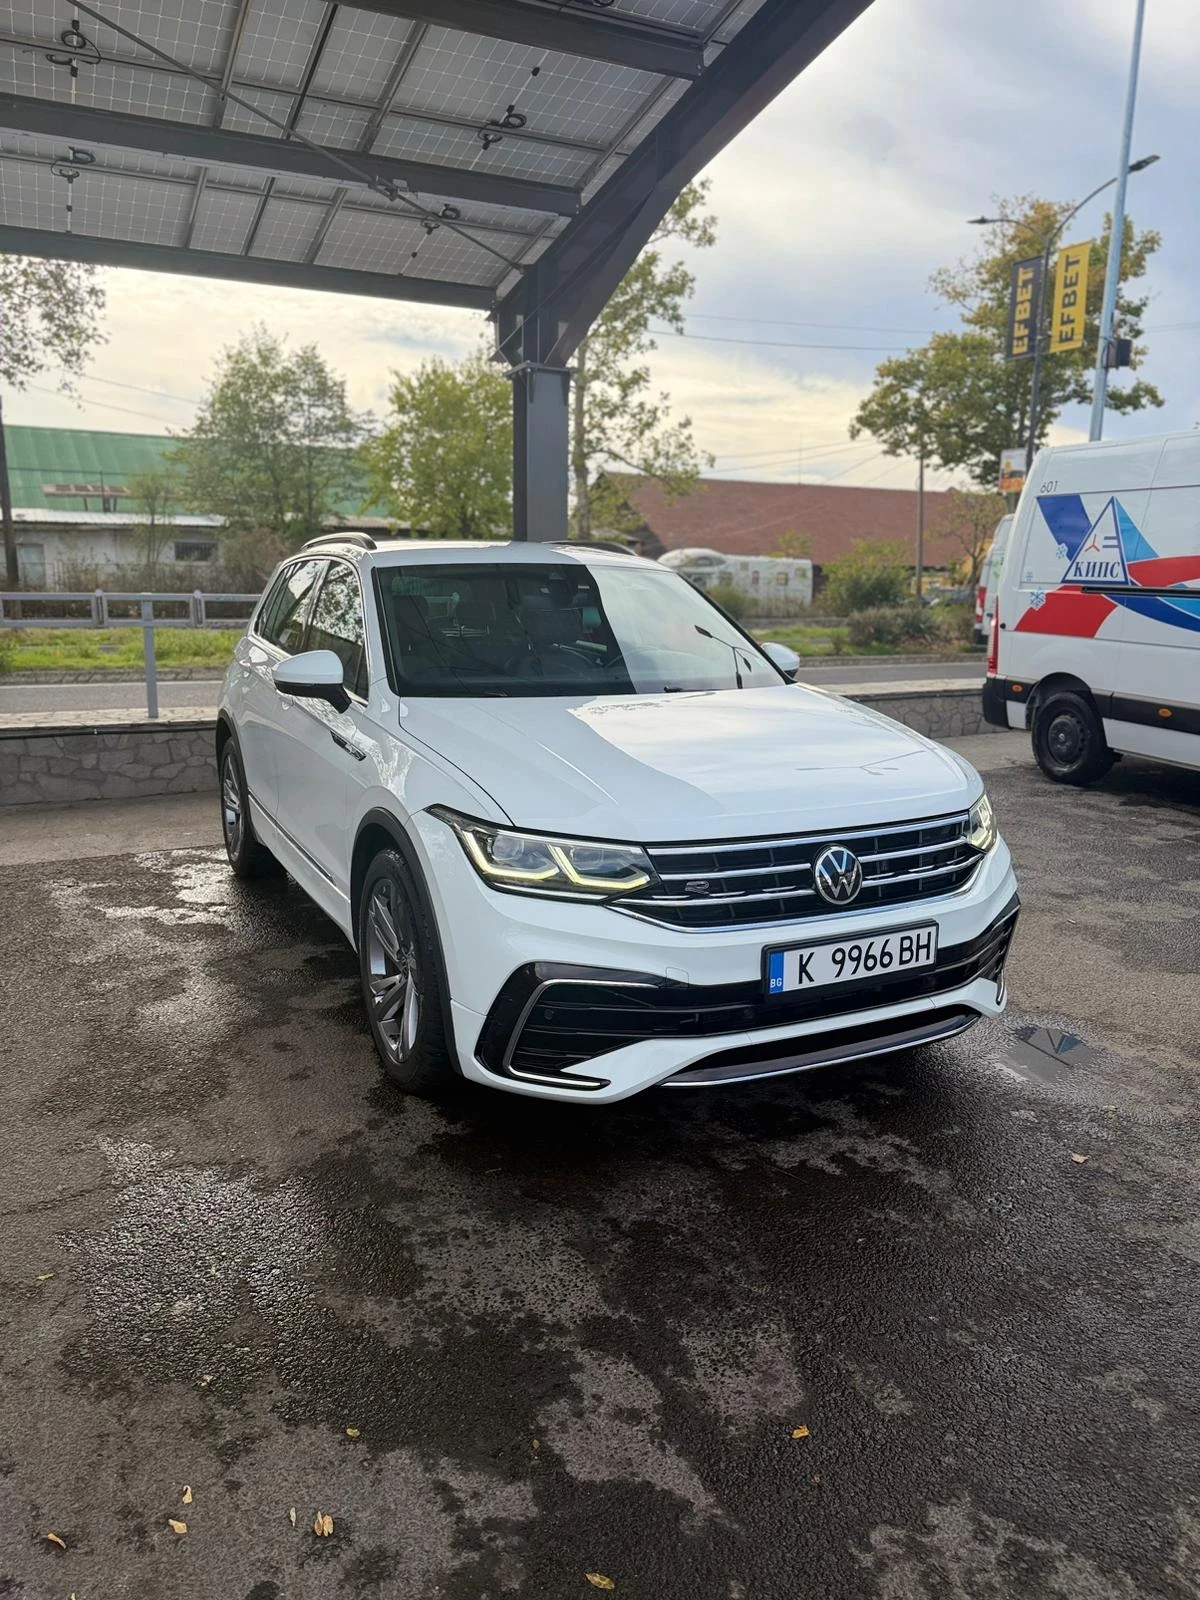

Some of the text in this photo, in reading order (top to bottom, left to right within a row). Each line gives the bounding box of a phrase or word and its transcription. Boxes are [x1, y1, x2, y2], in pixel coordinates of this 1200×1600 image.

[1012, 267, 1034, 355] EFBET
[1058, 254, 1080, 344] EFBET
[1040, 480, 1058, 494] 601
[1073, 561, 1120, 579] КИПС
[798, 931, 932, 984] K 9966 BH
[770, 977, 782, 988] BG
